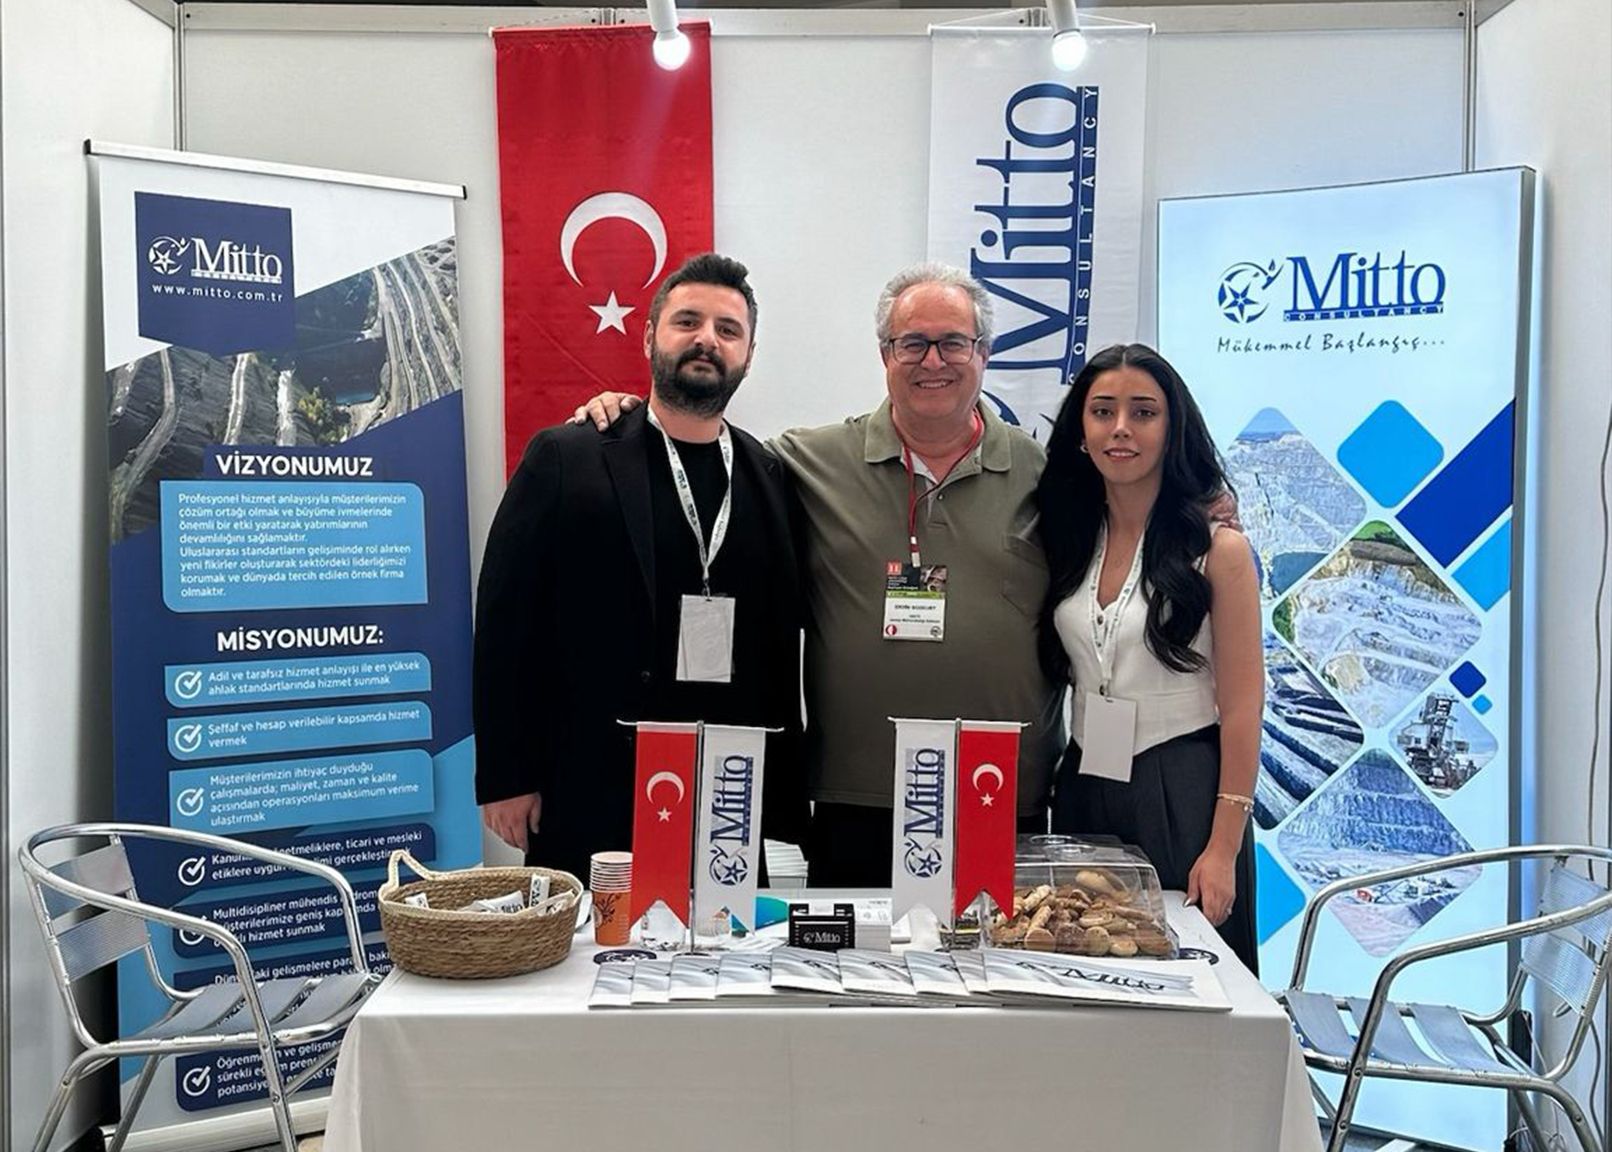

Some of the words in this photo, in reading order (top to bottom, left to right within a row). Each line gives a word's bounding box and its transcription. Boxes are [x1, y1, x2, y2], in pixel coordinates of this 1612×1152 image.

[970, 83, 1083, 385] Mitto
[191, 237, 282, 278] Mitto
[1286, 250, 1446, 311] Mitto
[152, 284, 283, 302] www.mitto.com.tr
[1284, 305, 1443, 321] CONSULTANCY
[1217, 334, 1312, 352] Mükemmel
[216, 451, 373, 477] VİZYONUMUZ
[178, 493, 239, 507] Profesyonel
[241, 494, 275, 504] hizmet
[278, 493, 329, 506] anlayışıyla
[331, 494, 406, 505] müşterilerimizin
[179, 508, 213, 518] çözüm
[215, 508, 246, 518] ortağı
[248, 507, 280, 517] olmak
[296, 508, 337, 518] büyüme
[179, 520, 215, 530] önemli
[217, 520, 230, 530] bir
[233, 520, 253, 530] etki
[255, 520, 301, 531] yaratarak
[180, 547, 240, 556] Uluslararası
[242, 545, 305, 556] standartların
[307, 544, 364, 556] gelişiminde
[366, 544, 378, 554] rol
[380, 543, 411, 554] alırken
[180, 560, 202, 572] yeni
[204, 560, 237, 570] fikirler
[240, 559, 296, 570] oluşturarak
[299, 557, 350, 567] sektördeki
[181, 574, 225, 584] korumak
[242, 572, 286, 584] dünyada
[288, 571, 317, 581] tercih
[319, 571, 349, 580] edilen
[351, 570, 378, 579] örnek
[380, 569, 404, 578] firma
[181, 587, 226, 598] olmaktır.
[217, 625, 384, 651] MİSYONUMUZ:
[208, 671, 229, 682] Adil
[246, 668, 283, 680] tarafsız
[285, 666, 320, 677] hizmet
[322, 665, 359, 676] anlayışı
[361, 664, 372, 672] ile
[374, 664, 386, 672] en
[388, 660, 420, 673] yüksek
[208, 684, 236, 696] ahlak
[238, 680, 315, 692] standartlarında
[318, 677, 352, 688] hizmet
[354, 674, 390, 686] sunmak
[241, 723, 254, 732] ve
[255, 720, 286, 731] hesap
[288, 714, 334, 727] verilebilir
[337, 711, 386, 726] kapsamda
[388, 709, 420, 720] hizmet
[208, 735, 248, 748] vermek
[210, 771, 292, 786] Müşterilerimizin
[294, 767, 328, 778] ihtiyaç
[329, 761, 373, 775] duyduğu
[323, 778, 356, 788] zaman
[357, 777, 370, 785] ve
[371, 772, 398, 783] kalite
[210, 799, 260, 812] açısından
[261, 792, 330, 808] operasyonları
[332, 787, 386, 800] maksimum
[710, 755, 748, 844] Mitto
[904, 748, 940, 836] Mitto
[210, 811, 266, 826] ulaştırmak
[346, 837, 371, 850] ticari
[373, 837, 385, 846] ve
[387, 830, 422, 844] mesleki
[212, 867, 252, 880] etiklere
[213, 902, 286, 919] Multidisipliner
[288, 894, 338, 909] mühendis
[295, 909, 323, 924] geniş
[248, 928, 284, 942] hizmet
[286, 922, 326, 938] sunmak
[283, 1047, 296, 1056] ve
